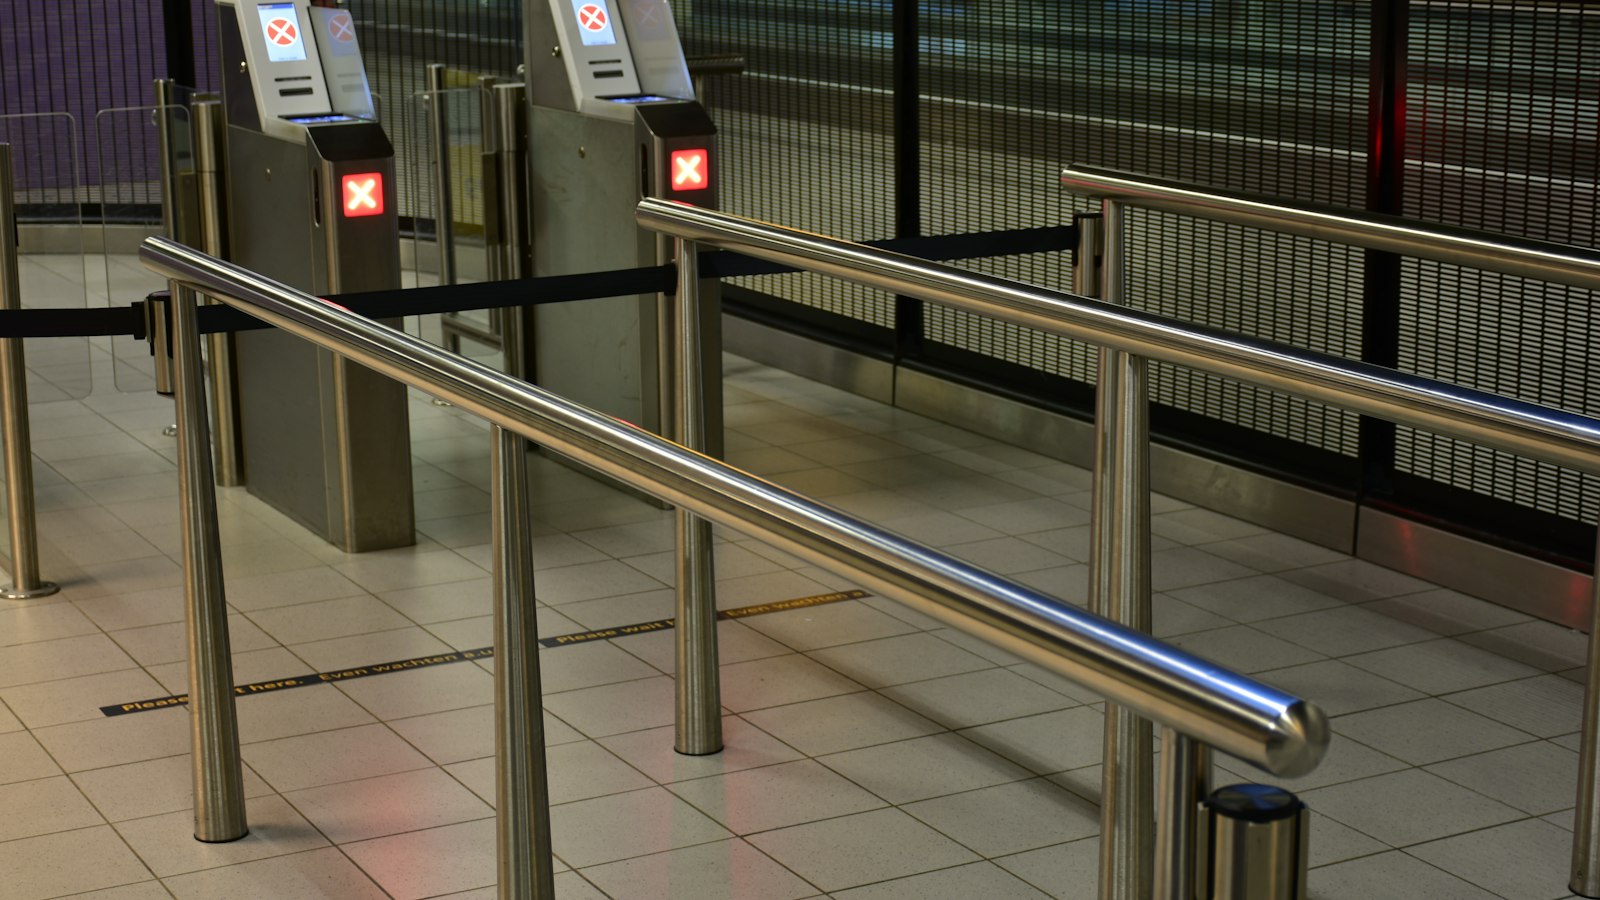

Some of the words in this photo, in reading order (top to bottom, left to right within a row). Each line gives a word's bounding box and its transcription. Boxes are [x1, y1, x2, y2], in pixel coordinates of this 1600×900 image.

[556, 629, 617, 644] Please
[121, 696, 188, 711] Please
[319, 669, 368, 681] Even
[372, 653, 458, 672] wachten
